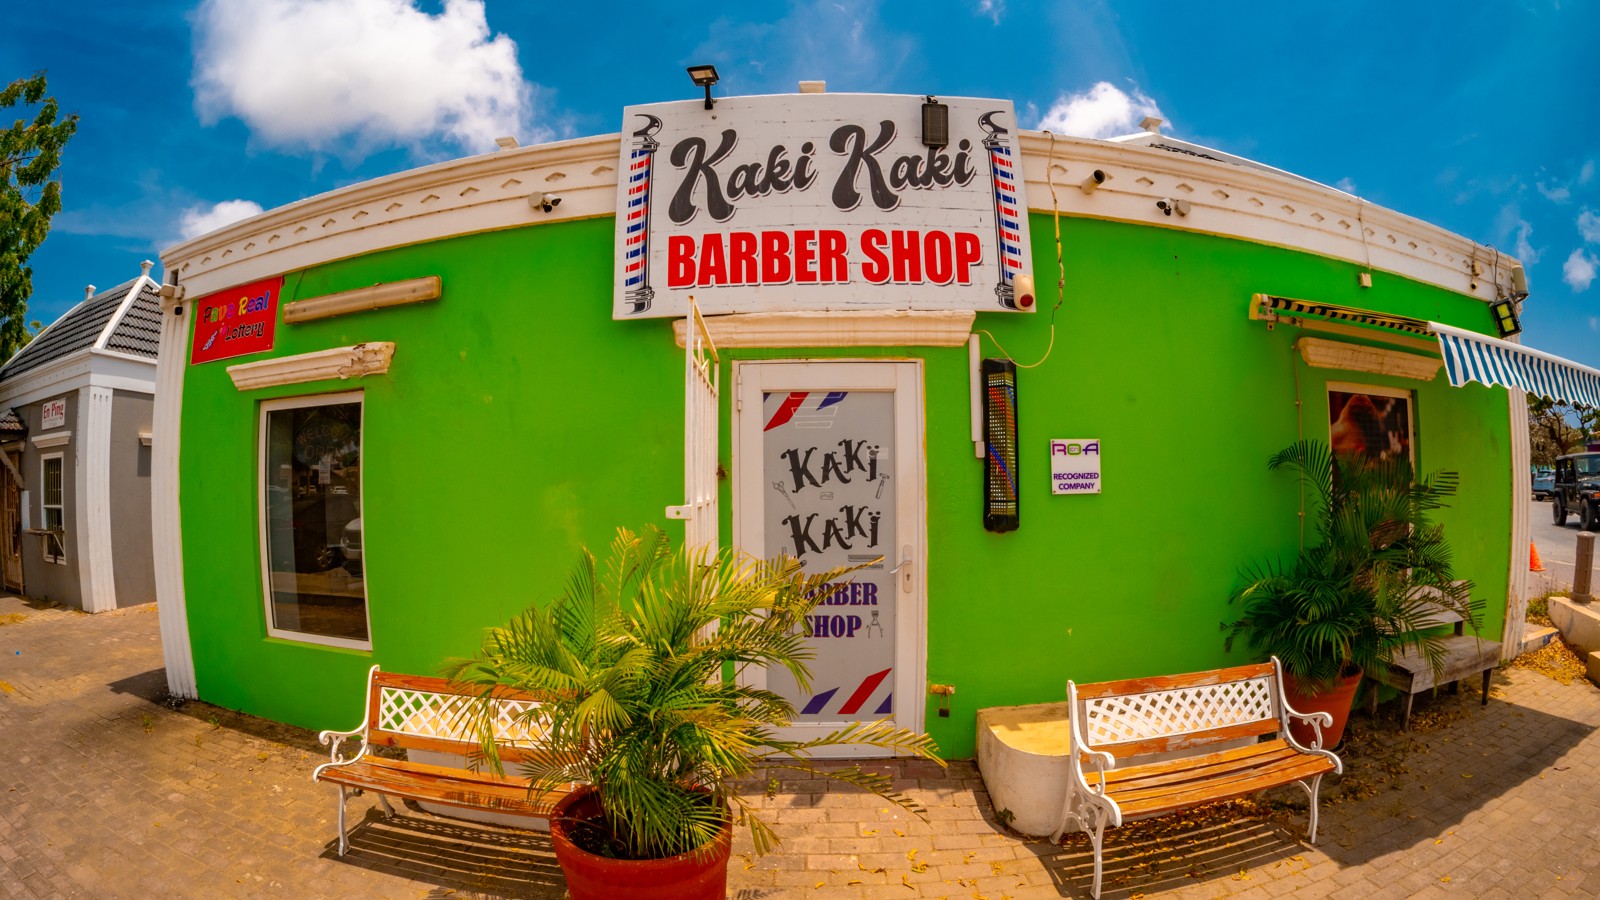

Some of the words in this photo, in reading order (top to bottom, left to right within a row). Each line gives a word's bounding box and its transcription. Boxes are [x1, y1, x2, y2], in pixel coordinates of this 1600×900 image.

[668, 128, 819, 226] Kaki
[829, 119, 977, 212] Kaki
[667, 229, 850, 289] BARBER
[860, 229, 983, 286] SHOP
[203, 303, 235, 324] Pavo
[238, 290, 271, 316] Real
[225, 321, 265, 341] Lottery
[44, 405, 50, 419] En
[51, 402, 63, 420] Ping
[1053, 472, 1099, 480] RECOGNIZED
[1058, 482, 1095, 490] COMPANY
[801, 582, 878, 606] ARBER
[803, 615, 862, 638] SHOP
